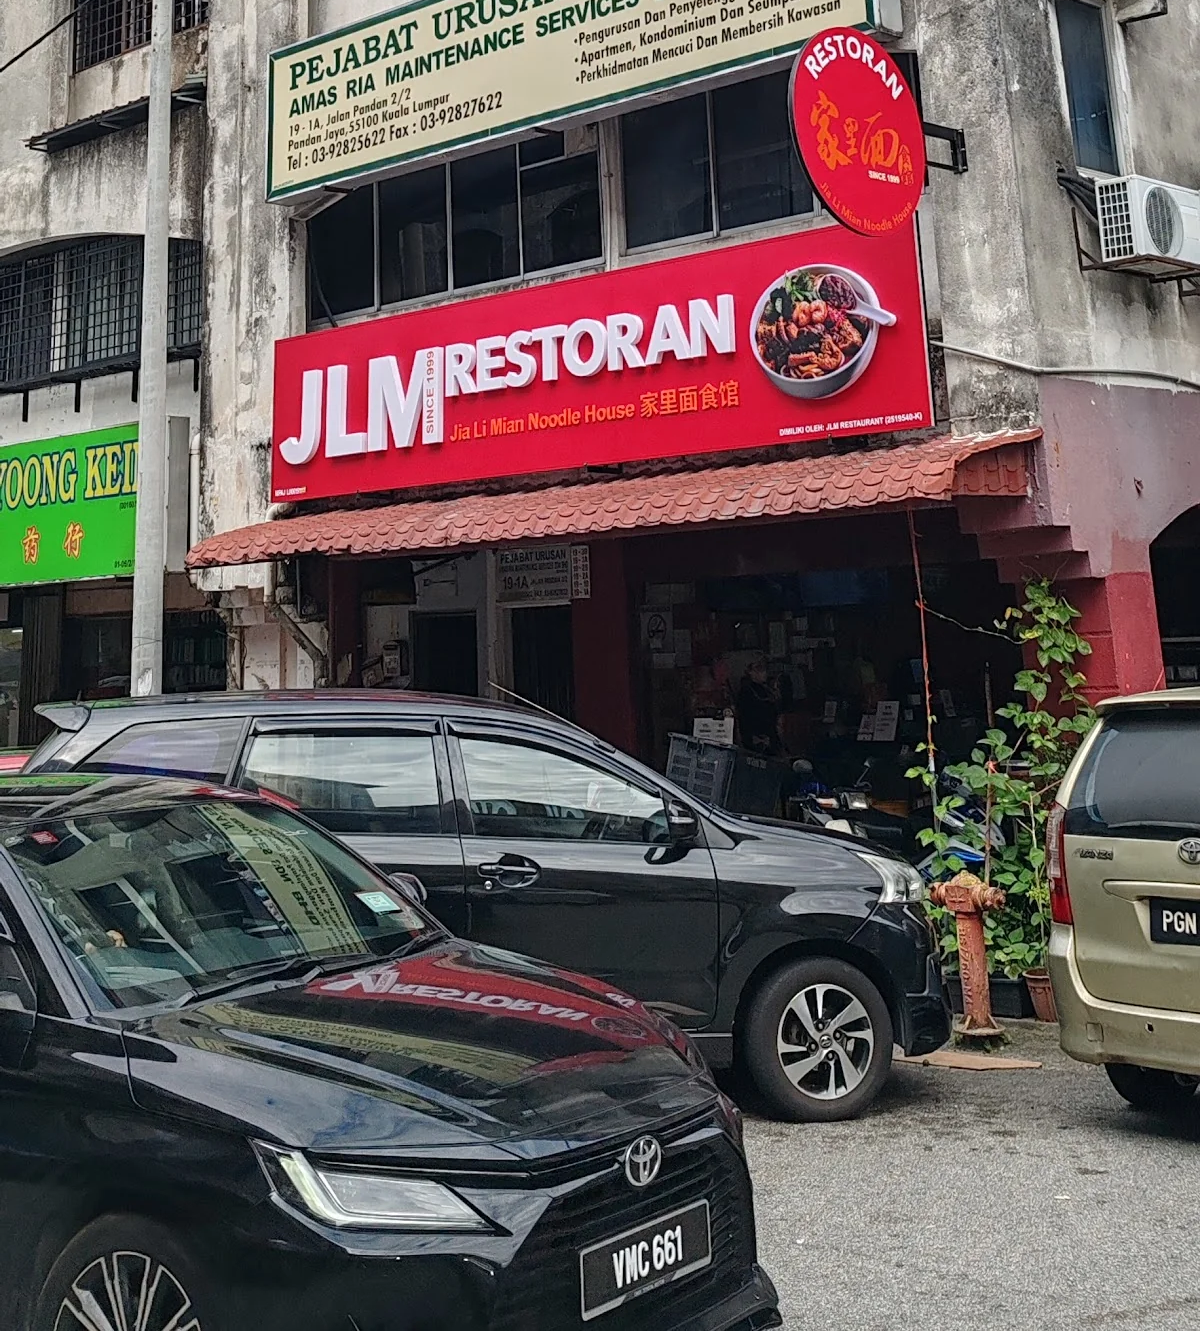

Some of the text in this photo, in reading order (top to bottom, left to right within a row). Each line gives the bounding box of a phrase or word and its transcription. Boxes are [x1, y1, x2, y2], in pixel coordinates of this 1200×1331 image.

[578, 19, 641, 46] Pengurusan
[644, 8, 667, 25] Dan
[580, 41, 637, 66] Apartmen,
[639, 15, 716, 48] Kondominium
[720, 5, 745, 23] Dan
[580, 0, 842, 84] Perkhidmatan Mencuci Dan Membersih Kawasan
[289, 20, 418, 90] PEJABAT
[289, 85, 337, 118] AMAS
[346, 73, 376, 100] RIA
[385, 23, 525, 86] MAINTENANCE
[804, 35, 904, 100] RESTORAN
[287, 155, 302, 171] Tel
[311, 128, 386, 164] 03-92825622
[389, 125, 409, 142] Fax
[420, 91, 503, 132] 03-92827622
[288, 132, 322, 152] Pandan
[382, 106, 410, 123] Kuala
[412, 93, 451, 114] Lumpur
[289, 125, 300, 137] 19
[326, 112, 350, 127] Jalan
[353, 97, 388, 118] Pandan
[391, 87, 411, 106] 2/2
[868, 170, 887, 182] SINCE
[820, 182, 912, 231] Jia Li Mian Noodle House
[279, 293, 736, 465] JLM RESTORAN
[426, 350, 435, 434] SINCE 1999
[640, 380, 739, 418] 家里面食馆
[450, 401, 635, 442] Jia Li Mian Noodle House
[826, 422, 840, 431] JLM
[840, 416, 884, 429] RESTAURANT
[22, 521, 84, 564] 药行
[500, 549, 566, 564] PEJABAT URUSAN
[503, 575, 529, 590] 19-1A
[1162, 910, 1198, 935] PGN
[612, 1240, 650, 1289] VMC
[652, 1225, 683, 1270] 661
